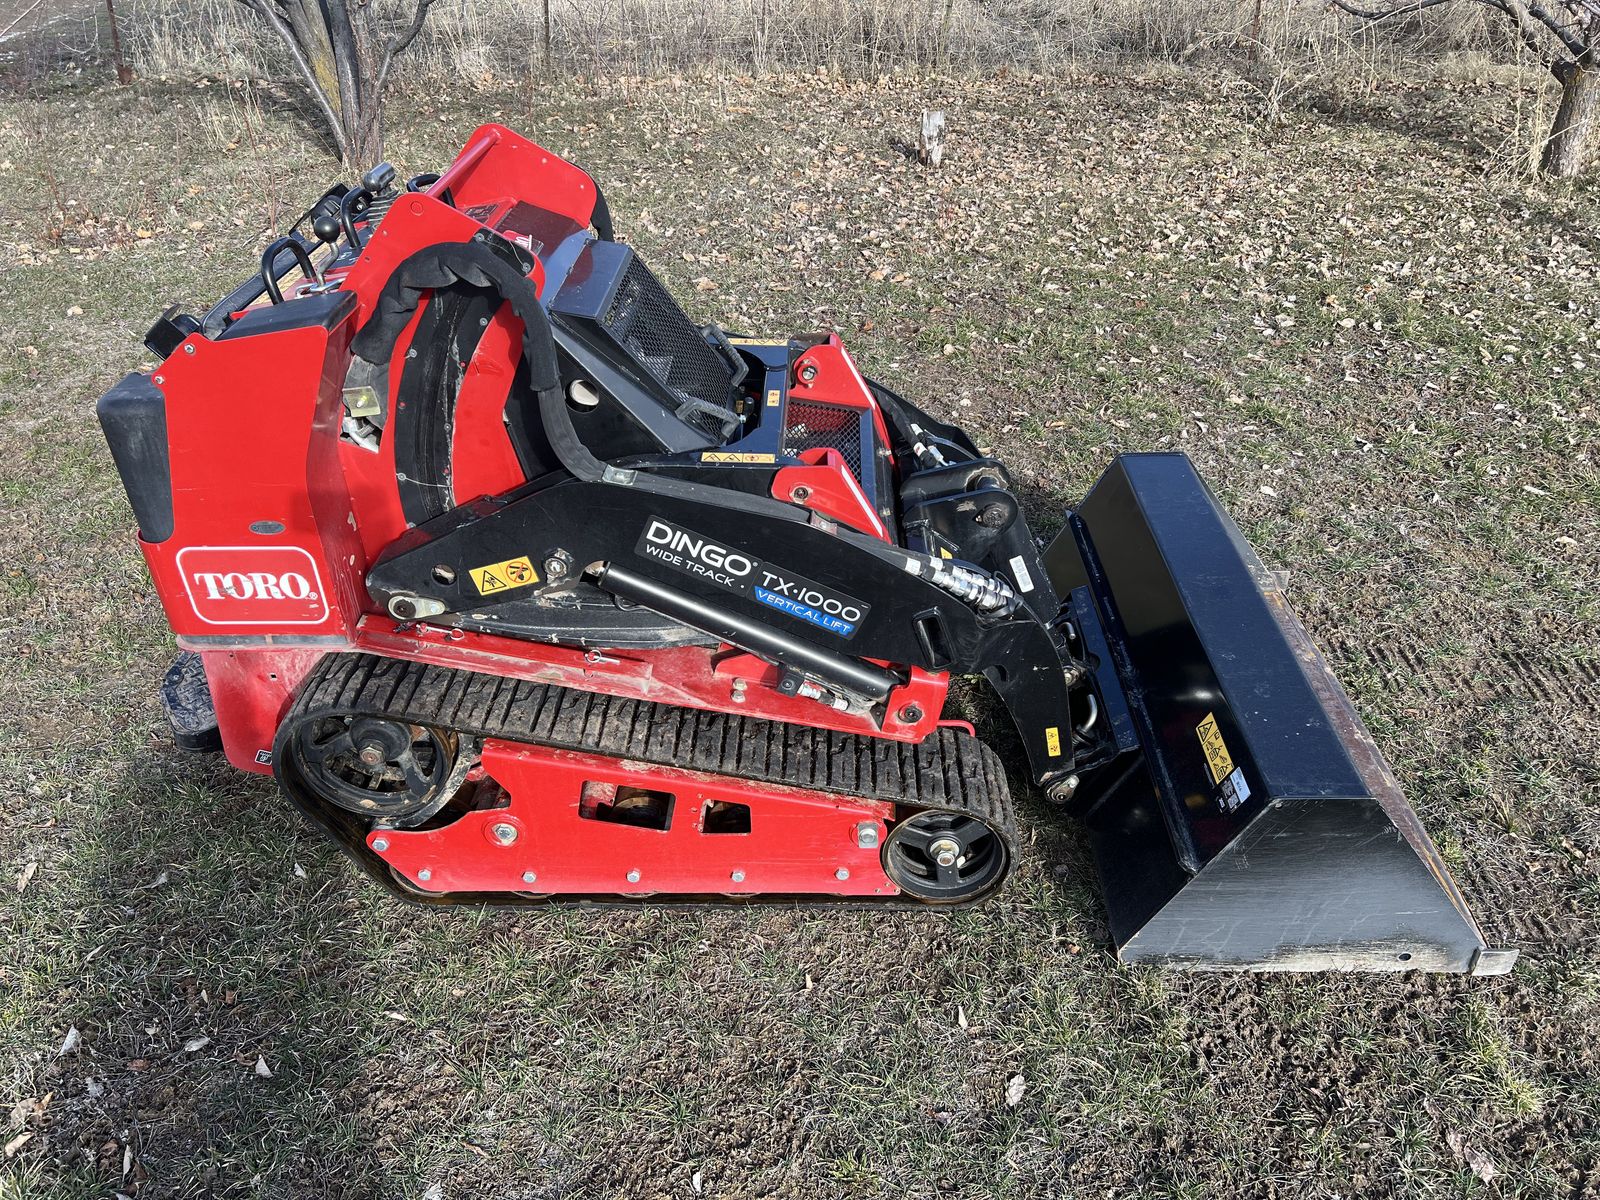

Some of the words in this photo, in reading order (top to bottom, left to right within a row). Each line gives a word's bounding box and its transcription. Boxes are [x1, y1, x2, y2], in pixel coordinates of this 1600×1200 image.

[646, 520, 752, 576] DINGO
[646, 544, 683, 566] WIDE
[685, 560, 735, 587] TRACK
[193, 572, 311, 600] TORO
[758, 589, 820, 622] VERTICAL
[822, 617, 851, 632] LIFT
